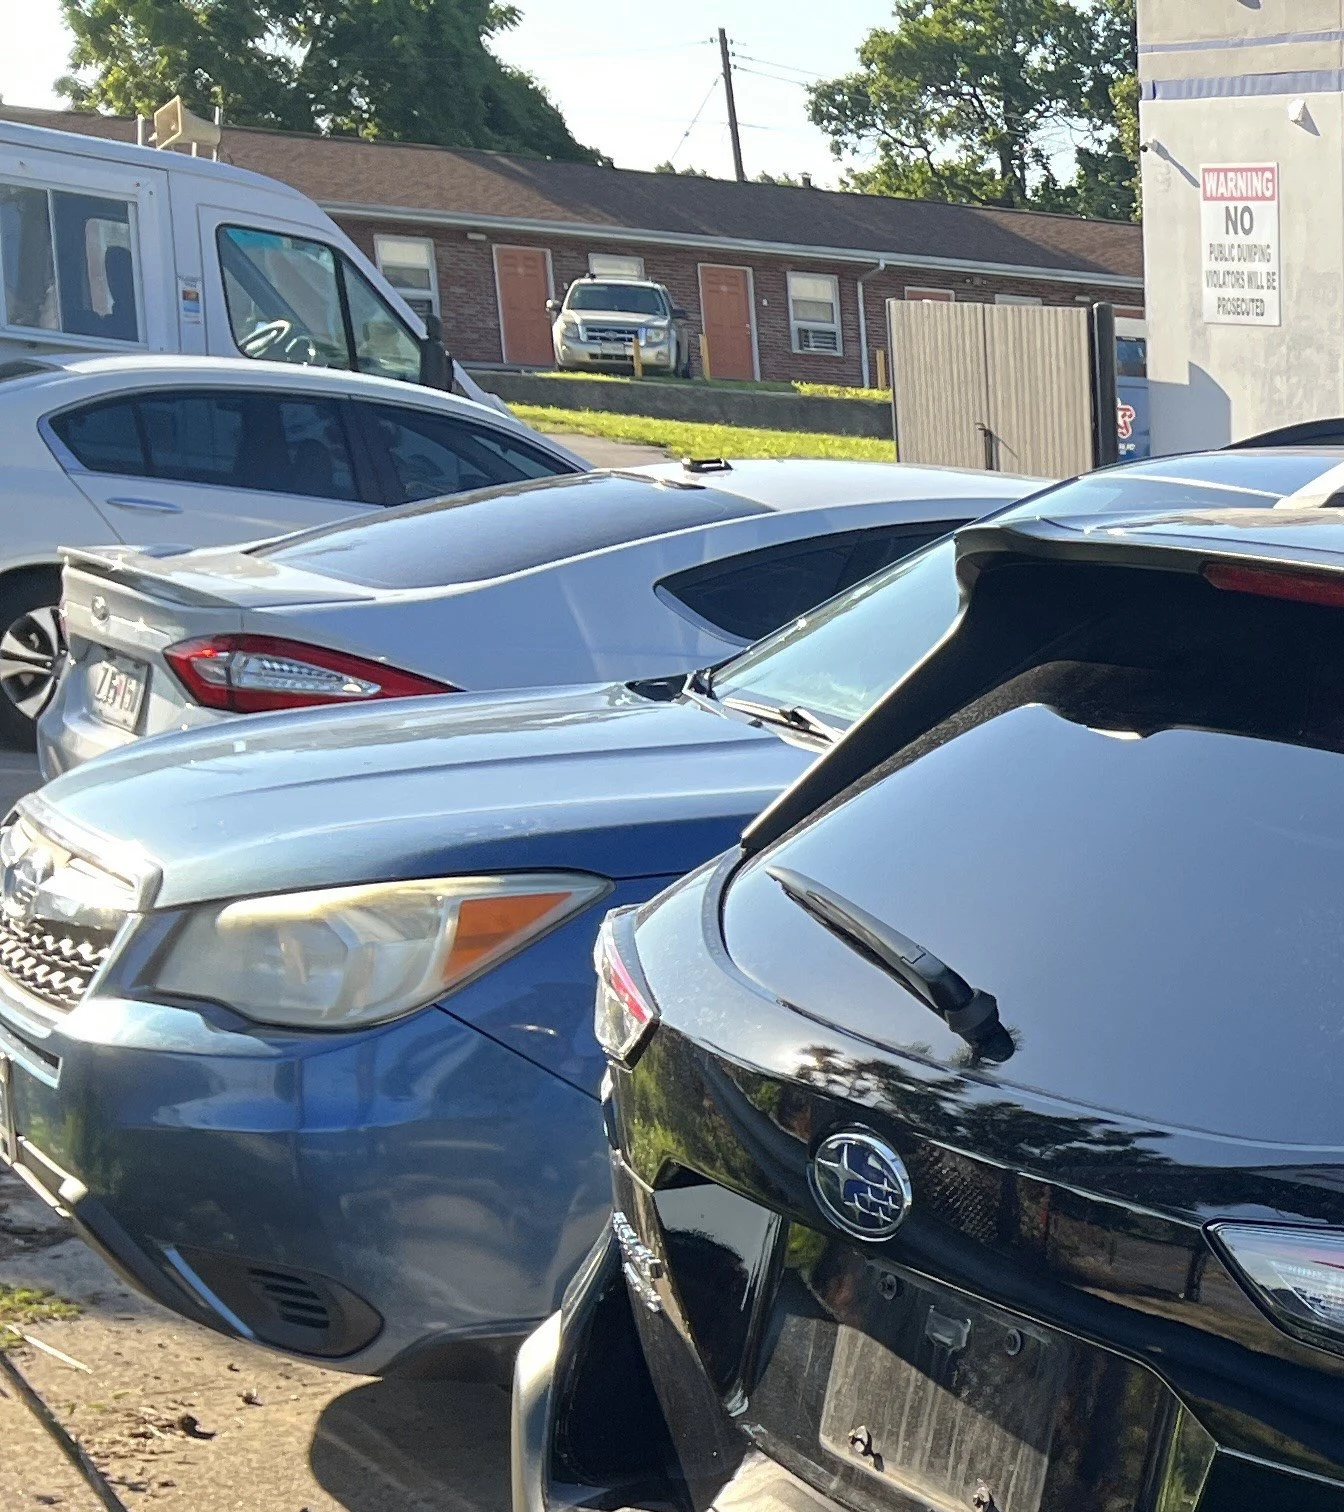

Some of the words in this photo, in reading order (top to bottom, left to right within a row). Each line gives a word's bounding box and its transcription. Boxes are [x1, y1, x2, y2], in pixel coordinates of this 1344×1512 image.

[1204, 171, 1273, 198] WARNING
[1225, 205, 1254, 236] NO
[1209, 243, 1235, 262] PUBLIC
[1237, 244, 1271, 262] DUMPING
[1205, 270, 1245, 289] VIOLATORS
[1247, 271, 1264, 289] WILL
[1266, 271, 1276, 290] BE
[1217, 297, 1265, 316] PROSECUTED
